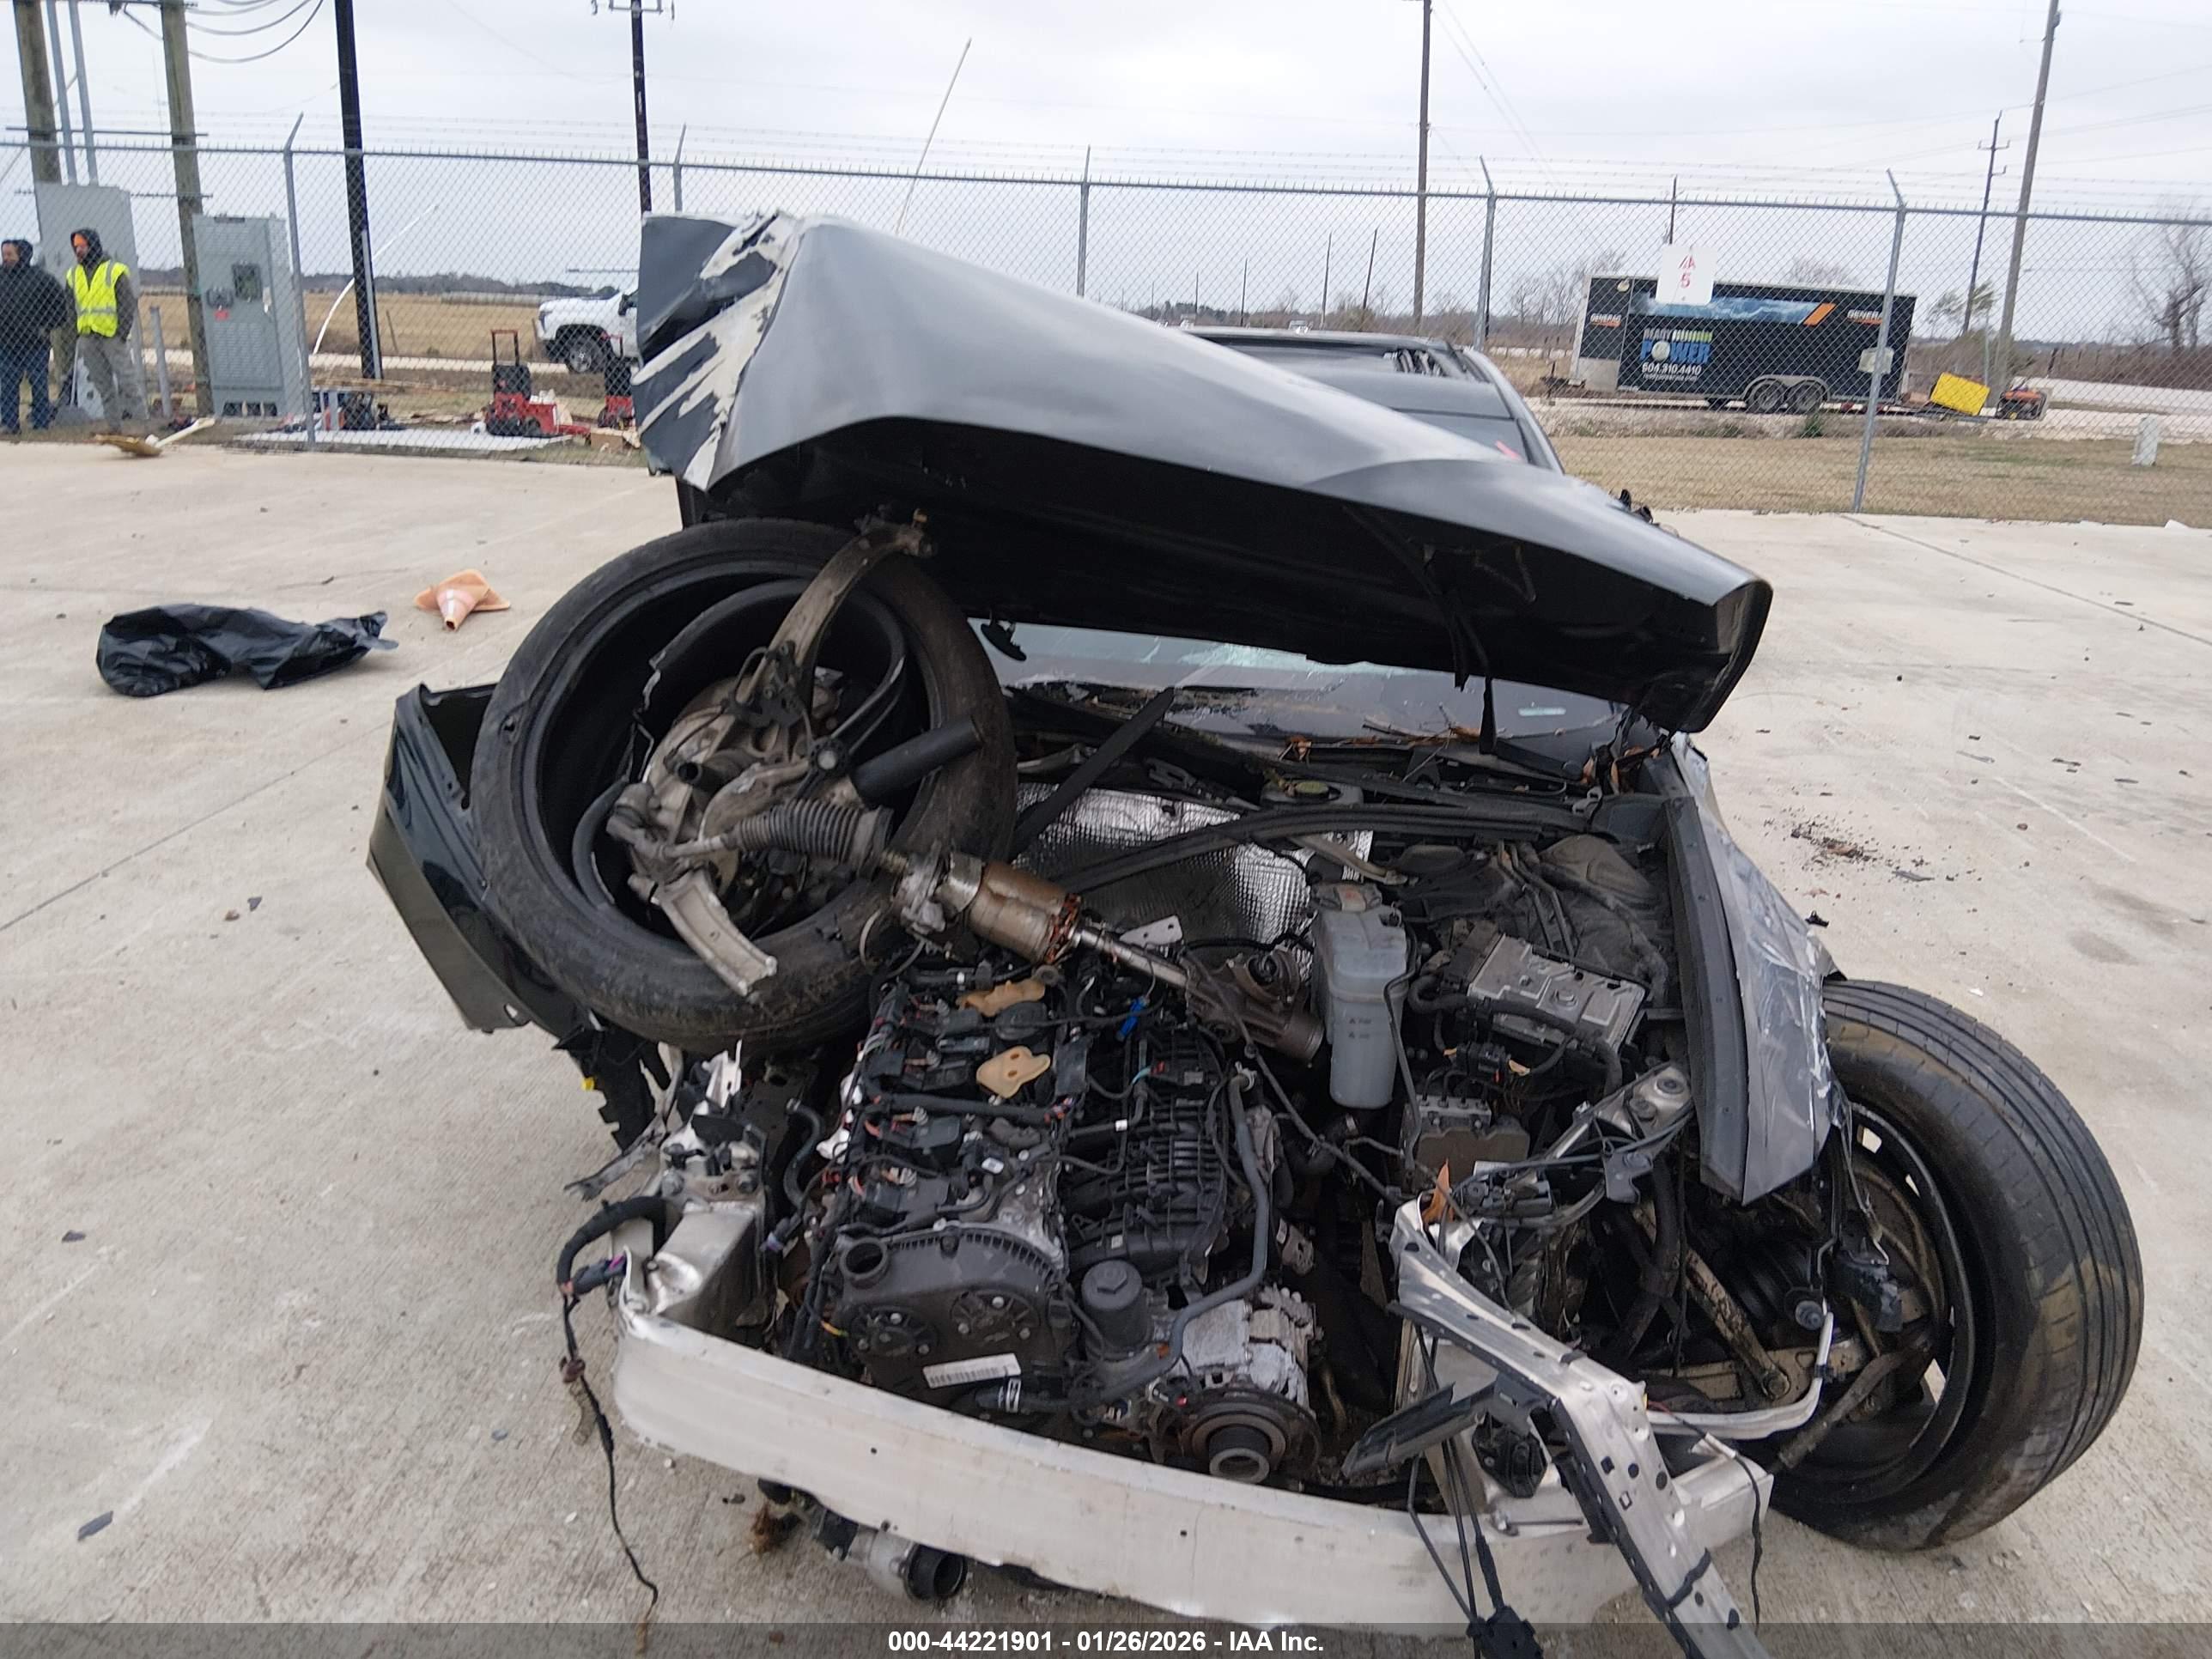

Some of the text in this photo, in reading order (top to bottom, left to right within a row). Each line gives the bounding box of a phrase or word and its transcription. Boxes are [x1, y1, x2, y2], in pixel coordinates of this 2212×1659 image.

[1680, 272, 1692, 289] 5
[1847, 309, 1883, 320] GENERA
[1640, 340, 1711, 363] POWER
